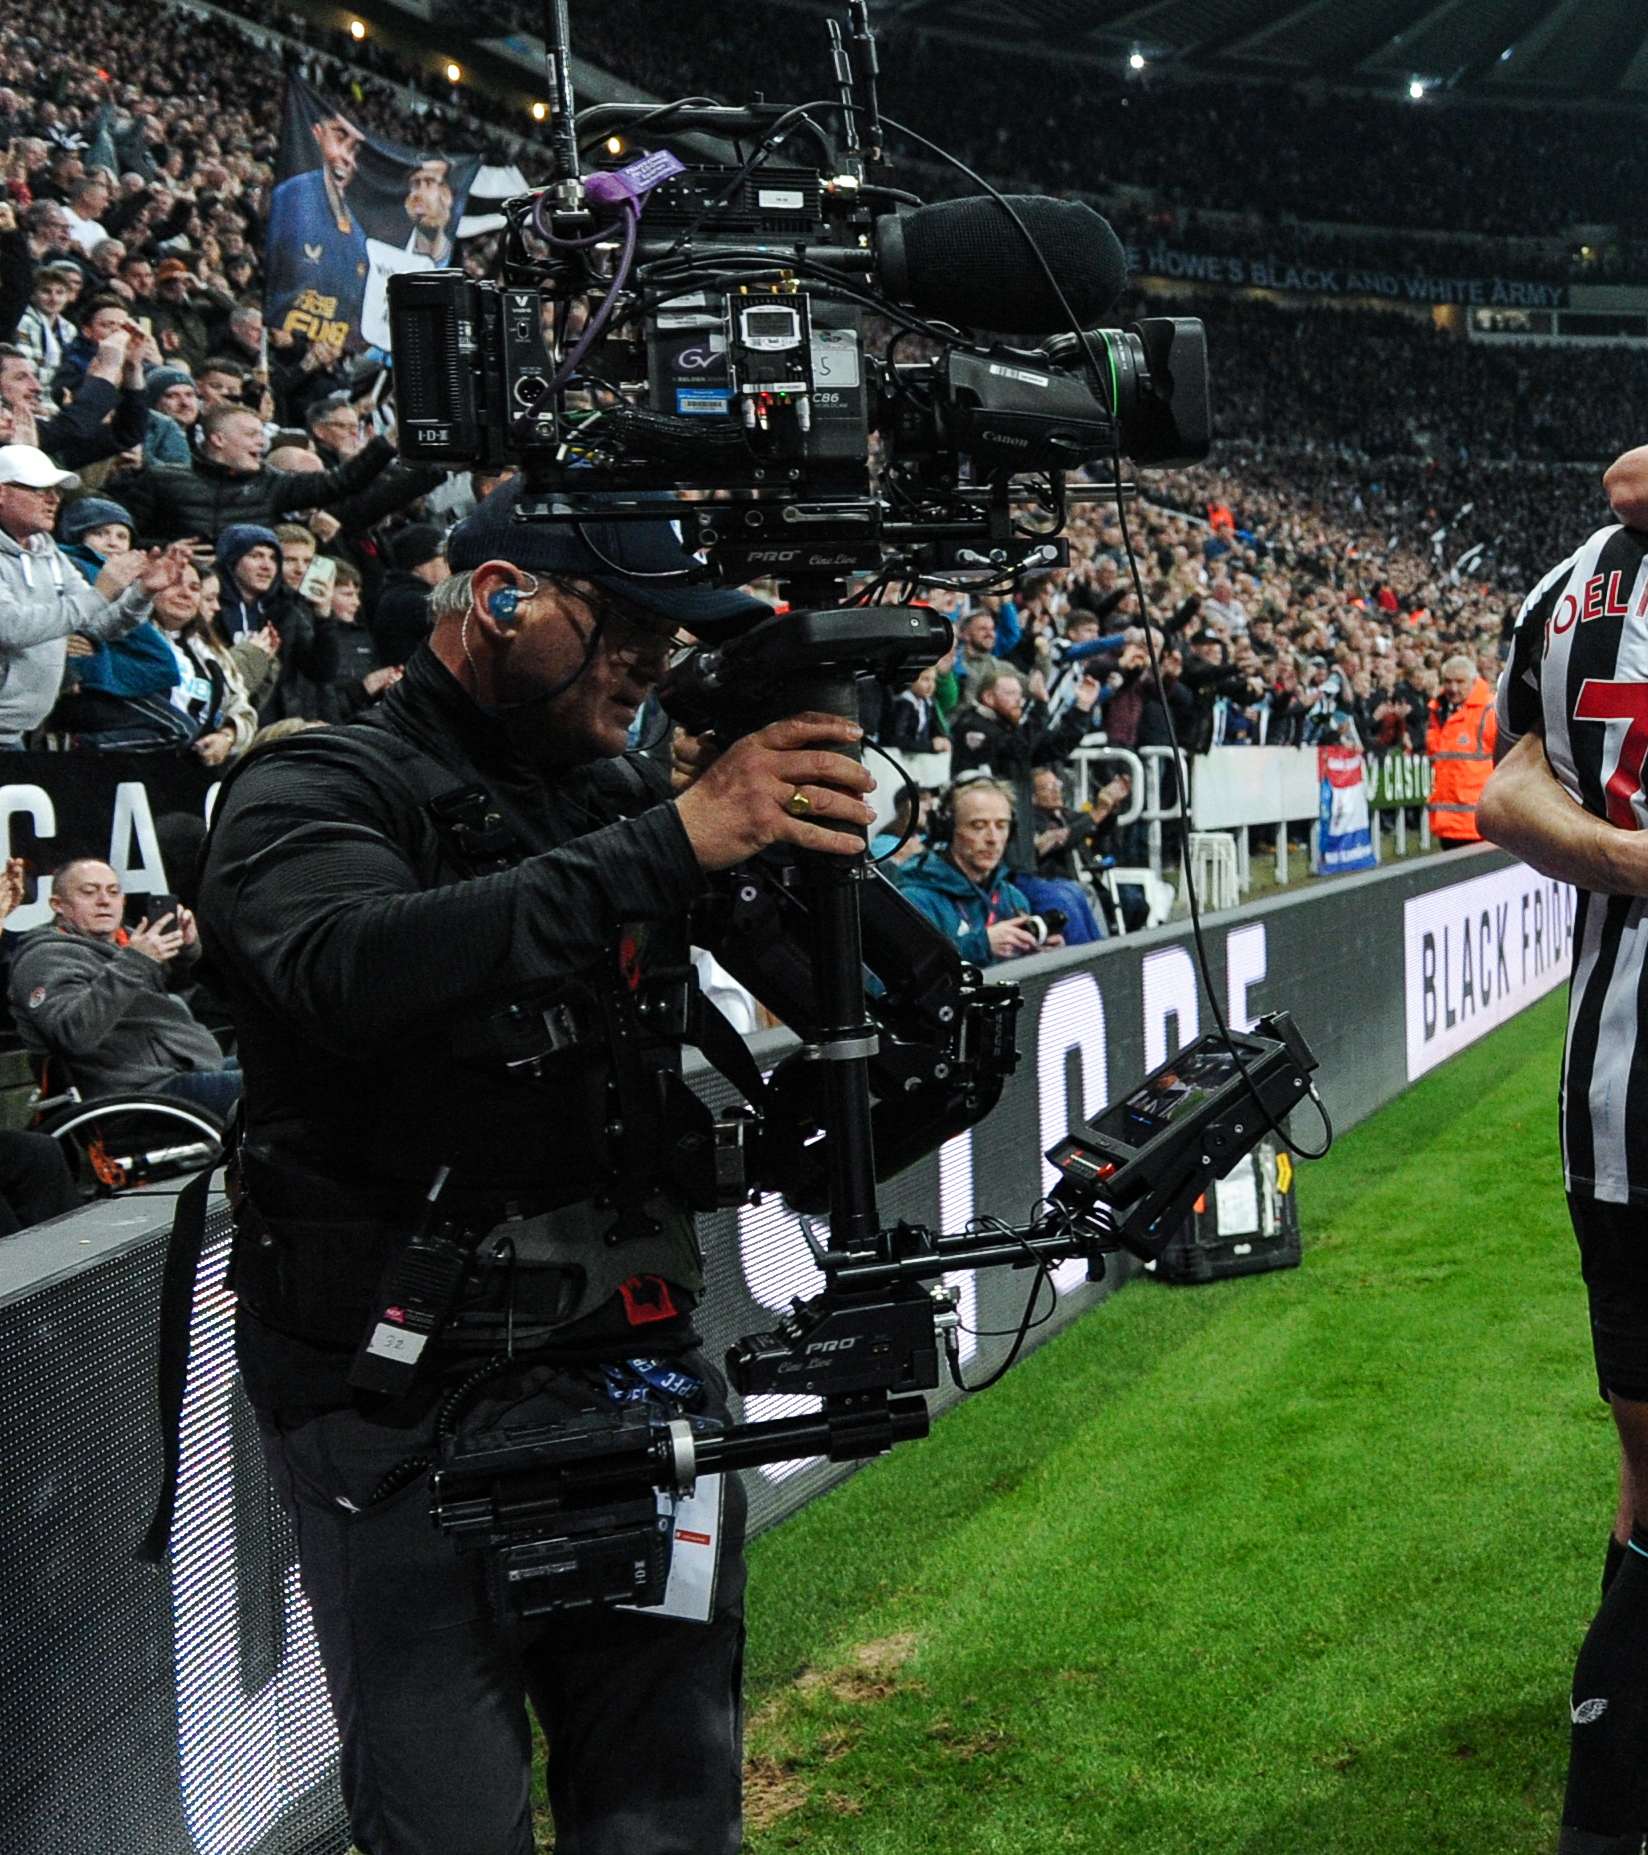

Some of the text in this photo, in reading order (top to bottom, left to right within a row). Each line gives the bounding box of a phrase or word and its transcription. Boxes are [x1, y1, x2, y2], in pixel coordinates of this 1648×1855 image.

[1252, 257, 1339, 290] BLACK
[1346, 272, 1399, 296] AND
[1405, 276, 1482, 301] WHITE
[1493, 279, 1563, 305] ARMY
[820, 356, 832, 376] 5
[982, 430, 1029, 448] Canon
[747, 550, 796, 562] PRO
[1422, 881, 1573, 1042] BLACK FRIDA
[805, 1337, 856, 1355] PRO
